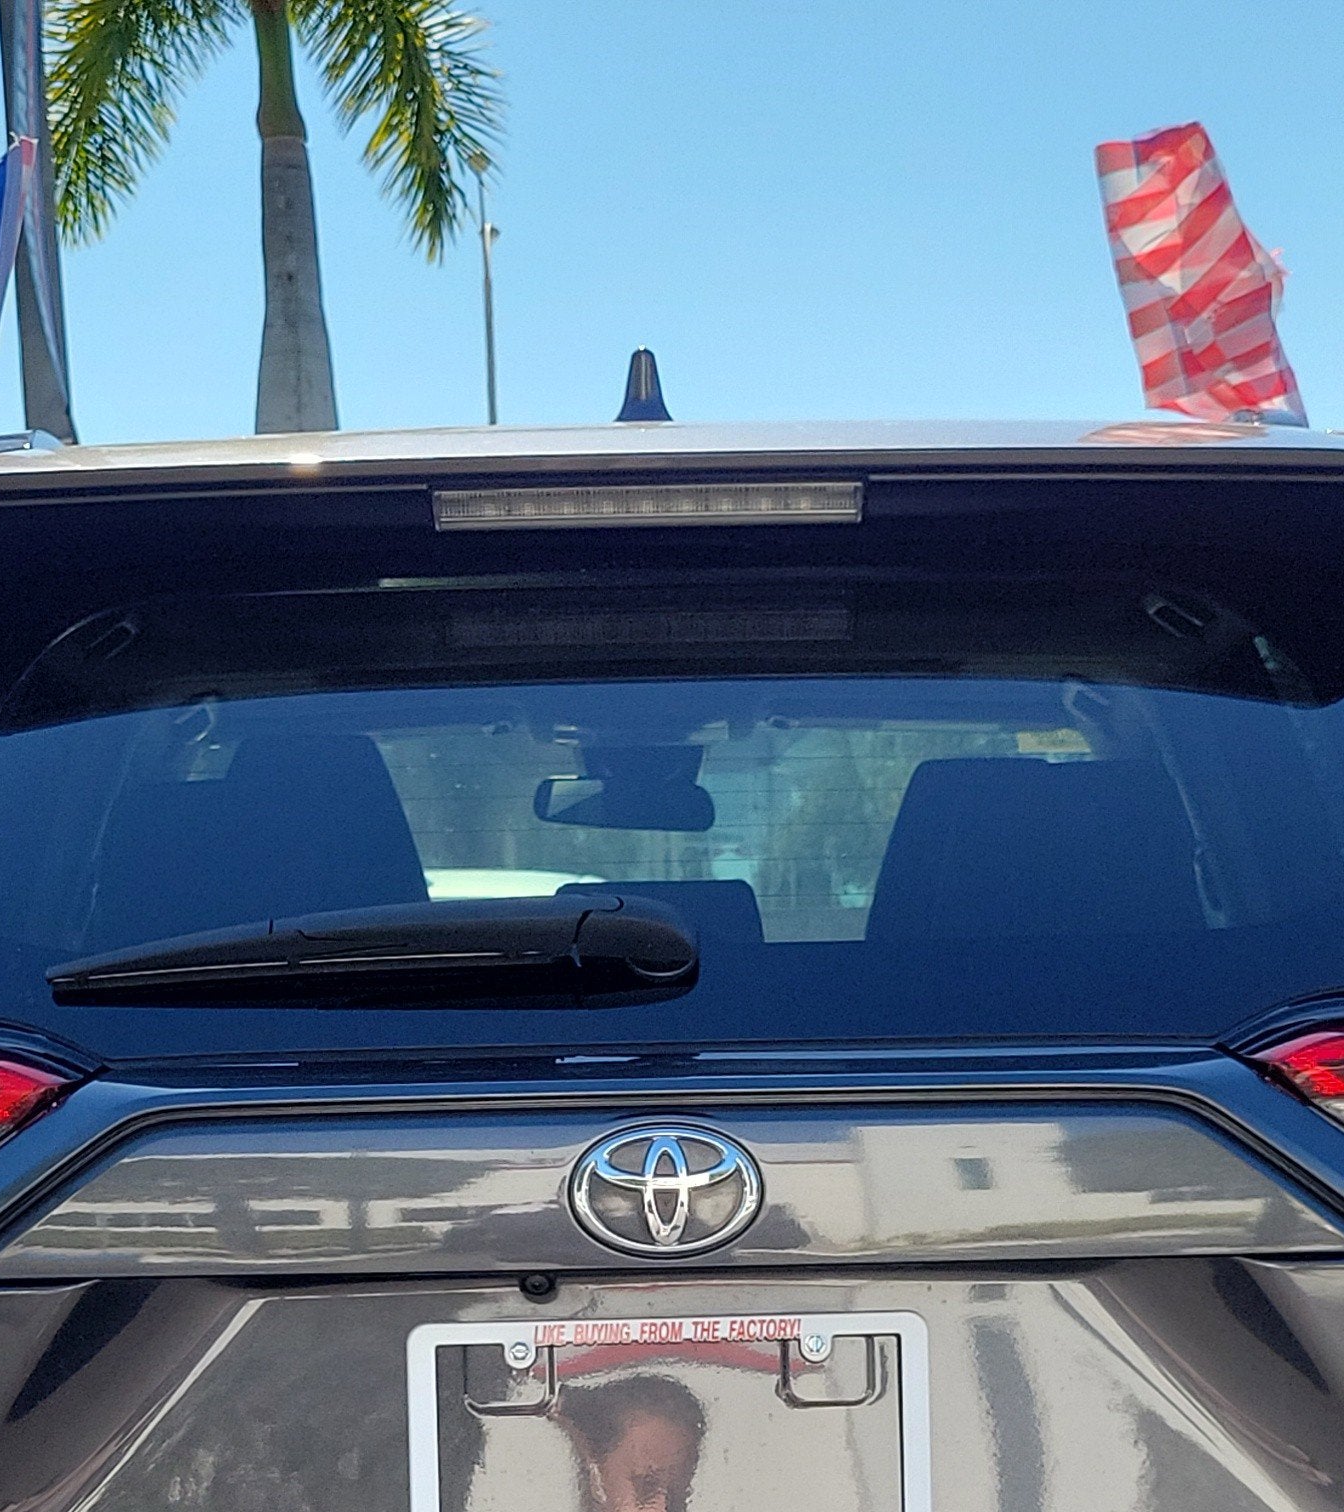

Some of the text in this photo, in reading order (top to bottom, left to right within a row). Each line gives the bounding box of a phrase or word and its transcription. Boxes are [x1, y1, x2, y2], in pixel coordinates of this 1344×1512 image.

[534, 1318, 802, 1344] LIKE BUYING FROM THE FACTORY!
